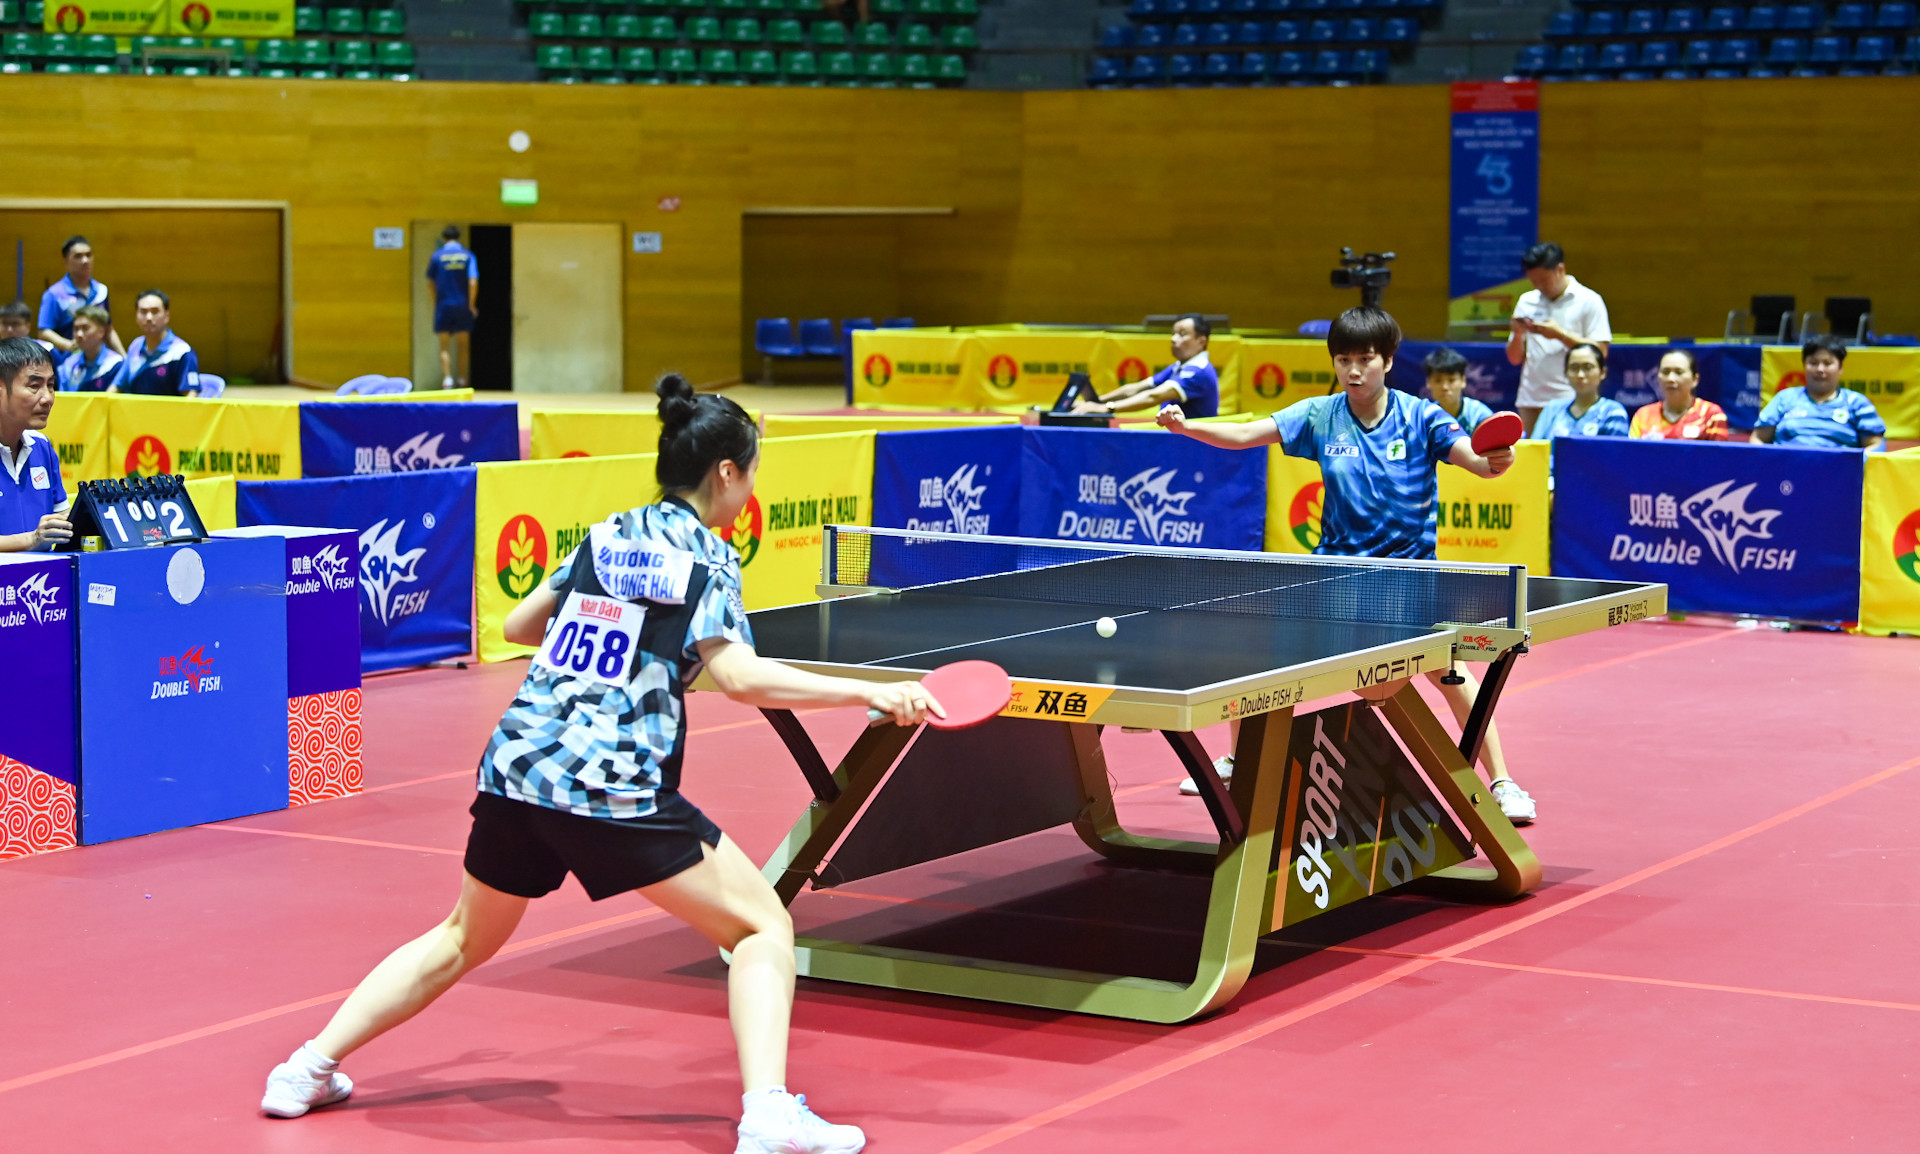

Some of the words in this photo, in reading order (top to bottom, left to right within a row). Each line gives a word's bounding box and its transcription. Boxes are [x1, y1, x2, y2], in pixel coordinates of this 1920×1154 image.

[1326, 445, 1356, 456] TAKE
[103, 506, 130, 543] 1
[160, 501, 193, 538] 2
[836, 495, 857, 524] MAU
[1452, 497, 1473, 529] CÀ
[1478, 503, 1513, 530] MAU
[1159, 520, 1205, 544] FISH
[1610, 534, 1702, 566] Double
[1741, 547, 1797, 572] FISH
[286, 579, 321, 596] Double
[334, 576, 355, 590] FISH
[0, 611, 27, 628] uble
[43, 608, 67, 623] FISH
[389, 589, 430, 620] FISH
[548, 621, 630, 679] 058
[198, 676, 221, 693] FISH
[1357, 654, 1425, 688] MOFIT
[1010, 704, 1029, 713] FISH
[1034, 690, 1087, 717] 双鱼
[1240, 692, 1271, 716] Double
[1272, 688, 1292, 708] FISH
[1296, 714, 1346, 910] SPORT
